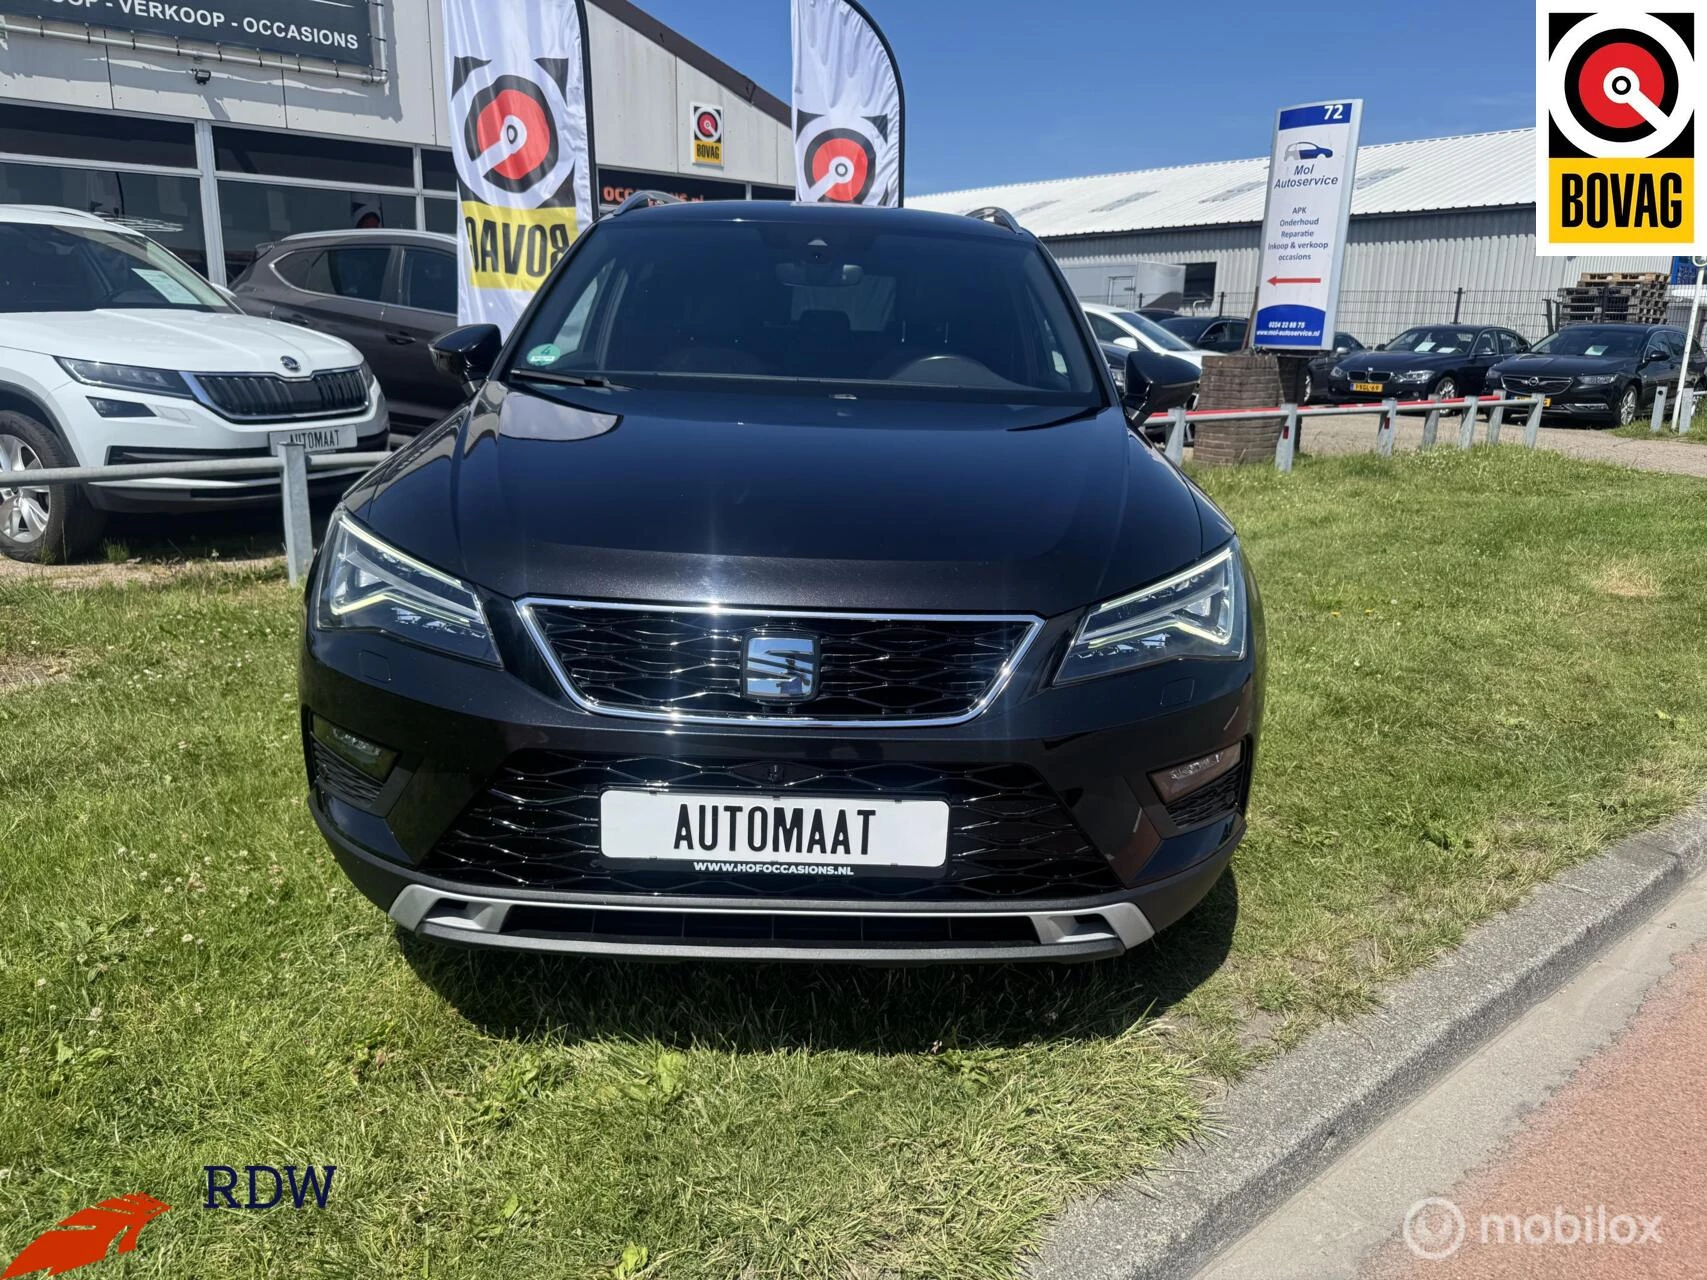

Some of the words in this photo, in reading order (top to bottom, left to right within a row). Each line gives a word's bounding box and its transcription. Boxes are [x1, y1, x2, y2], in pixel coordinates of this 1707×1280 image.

[119, 0, 225, 27] VERKOOP
[243, 17, 359, 49] OCCASIONS
[1324, 104, 1344, 120] 72
[696, 143, 720, 160] BOVAG
[1293, 164, 1315, 176] Mol
[1273, 175, 1338, 189] Autoservice
[1292, 206, 1307, 214] APK
[1280, 217, 1320, 227] Onderhoud
[1281, 229, 1314, 239] Reparatie
[1298, 241, 1329, 250] verkoop
[1278, 253, 1311, 261] occasions
[674, 803, 876, 855] AUTOMAAT
[693, 861, 854, 876] WWW.HOFOCCASIONS.NL
